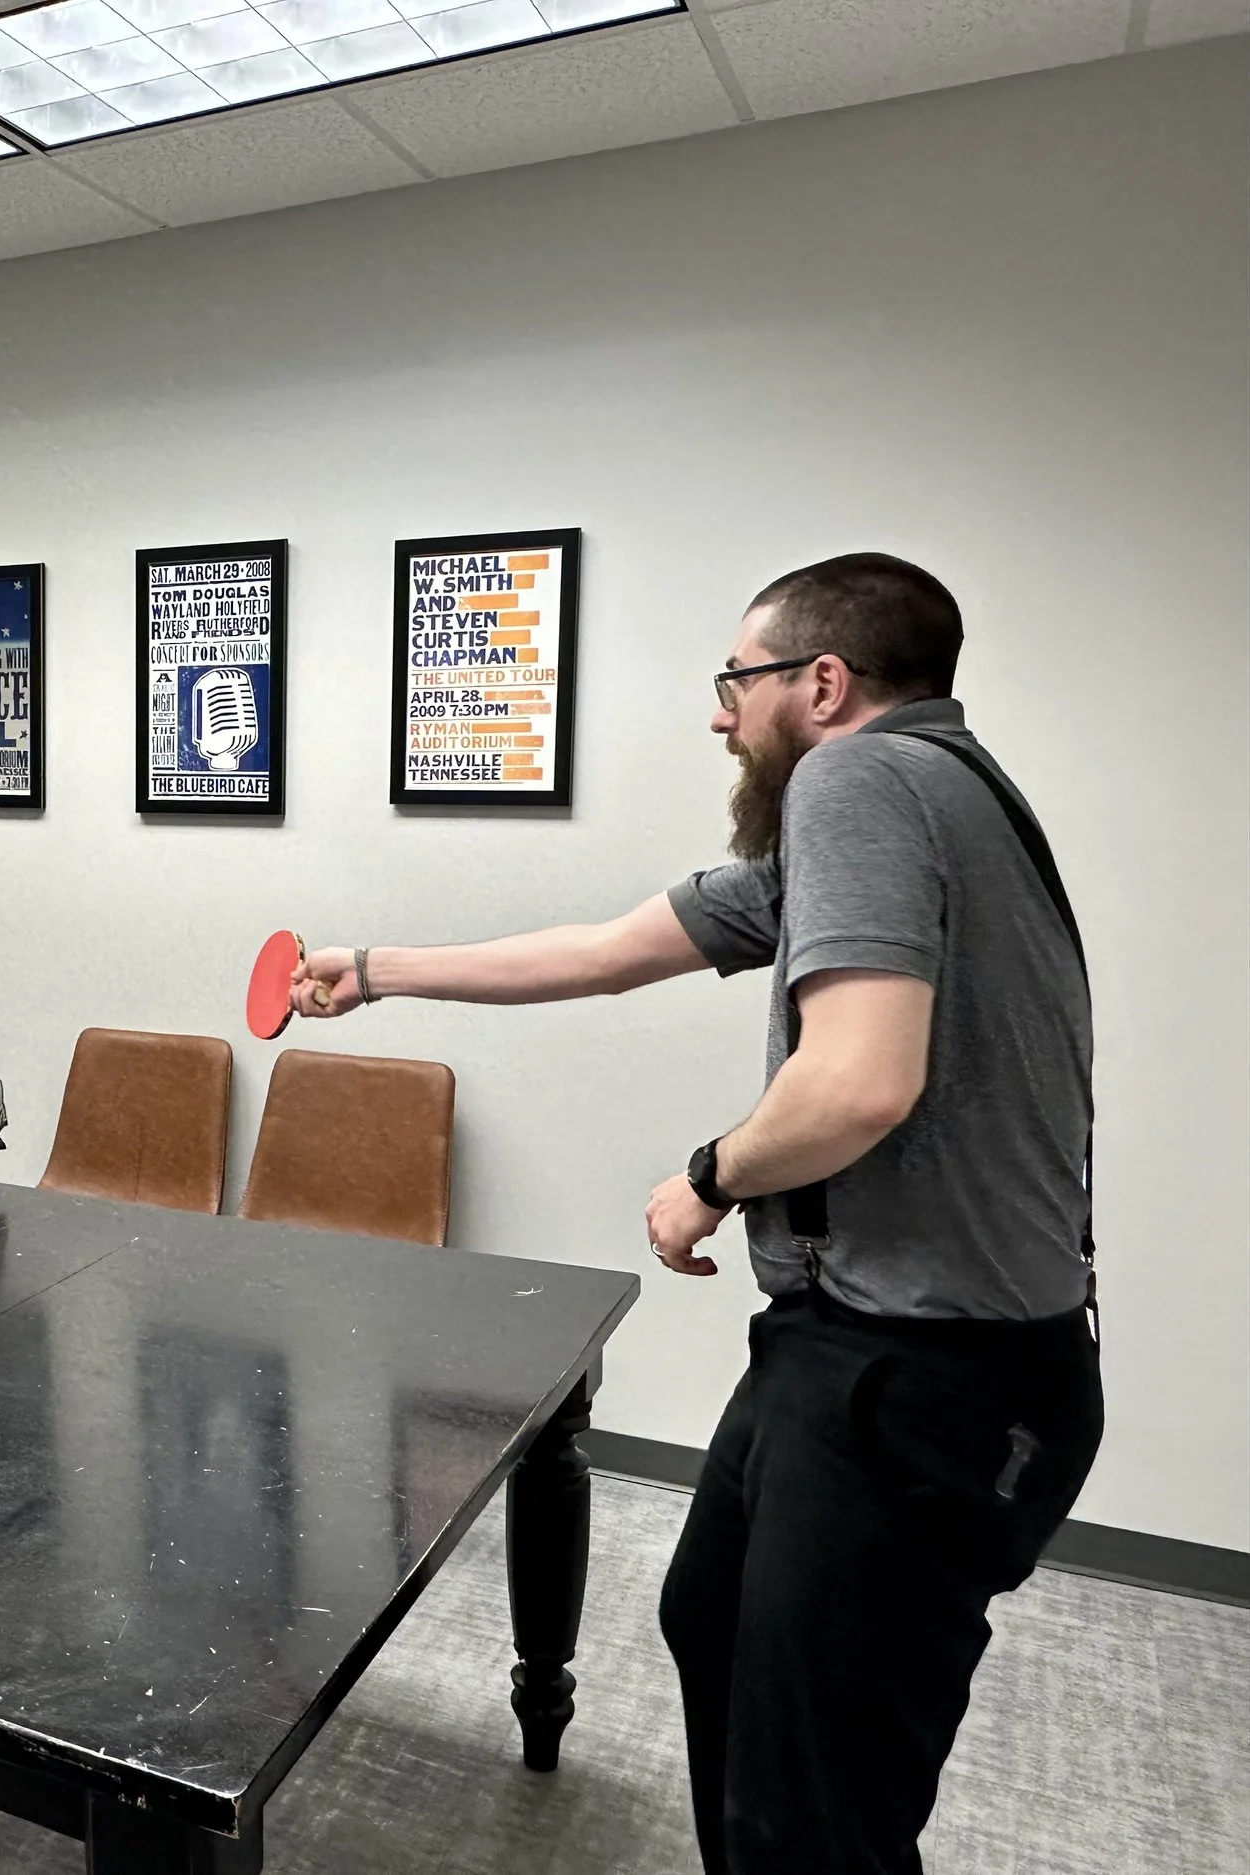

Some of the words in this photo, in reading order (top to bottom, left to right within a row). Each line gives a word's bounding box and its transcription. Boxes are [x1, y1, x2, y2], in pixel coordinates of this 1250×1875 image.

[175, 563, 221, 582] MARCH
[223, 563, 239, 579] 29
[245, 561, 270, 577] 2008
[413, 555, 505, 577] MICHAEL
[414, 578, 439, 595] W.
[443, 573, 512, 593] SMITH
[151, 590, 187, 603] TOM
[193, 586, 270, 601] DOUGLAS
[151, 602, 210, 620] WAYLAND
[215, 599, 270, 617] HOLYFIELD
[413, 596, 456, 613] AND
[151, 620, 190, 640] RIVERS
[196, 616, 270, 636] RUTHERFORD
[412, 611, 498, 631] STEVEN
[164, 631, 187, 640] AND
[411, 630, 489, 649] CURTIS
[5, 647, 28, 669] WITH
[151, 645, 189, 664] CONCERT
[192, 646, 218, 662] FOR
[220, 642, 270, 663] SPONSORS
[411, 647, 516, 667] CHAPMAN
[156, 673, 172, 683] A
[411, 673, 443, 685] THE
[448, 671, 505, 684] UNITED
[510, 668, 556, 682] TOUR
[411, 691, 459, 703] APRIL
[410, 705, 446, 717] 2009
[450, 704, 482, 716] 7:30
[484, 703, 509, 715] PM
[410, 722, 470, 735] RYMAN
[411, 735, 512, 749] AUDITORIUM
[408, 753, 502, 767] NASHVILLE
[408, 768, 501, 781] TENNESSEE
[151, 778, 174, 793] THE
[176, 778, 235, 793] BLUEBIRD
[238, 779, 269, 794] CAFE
